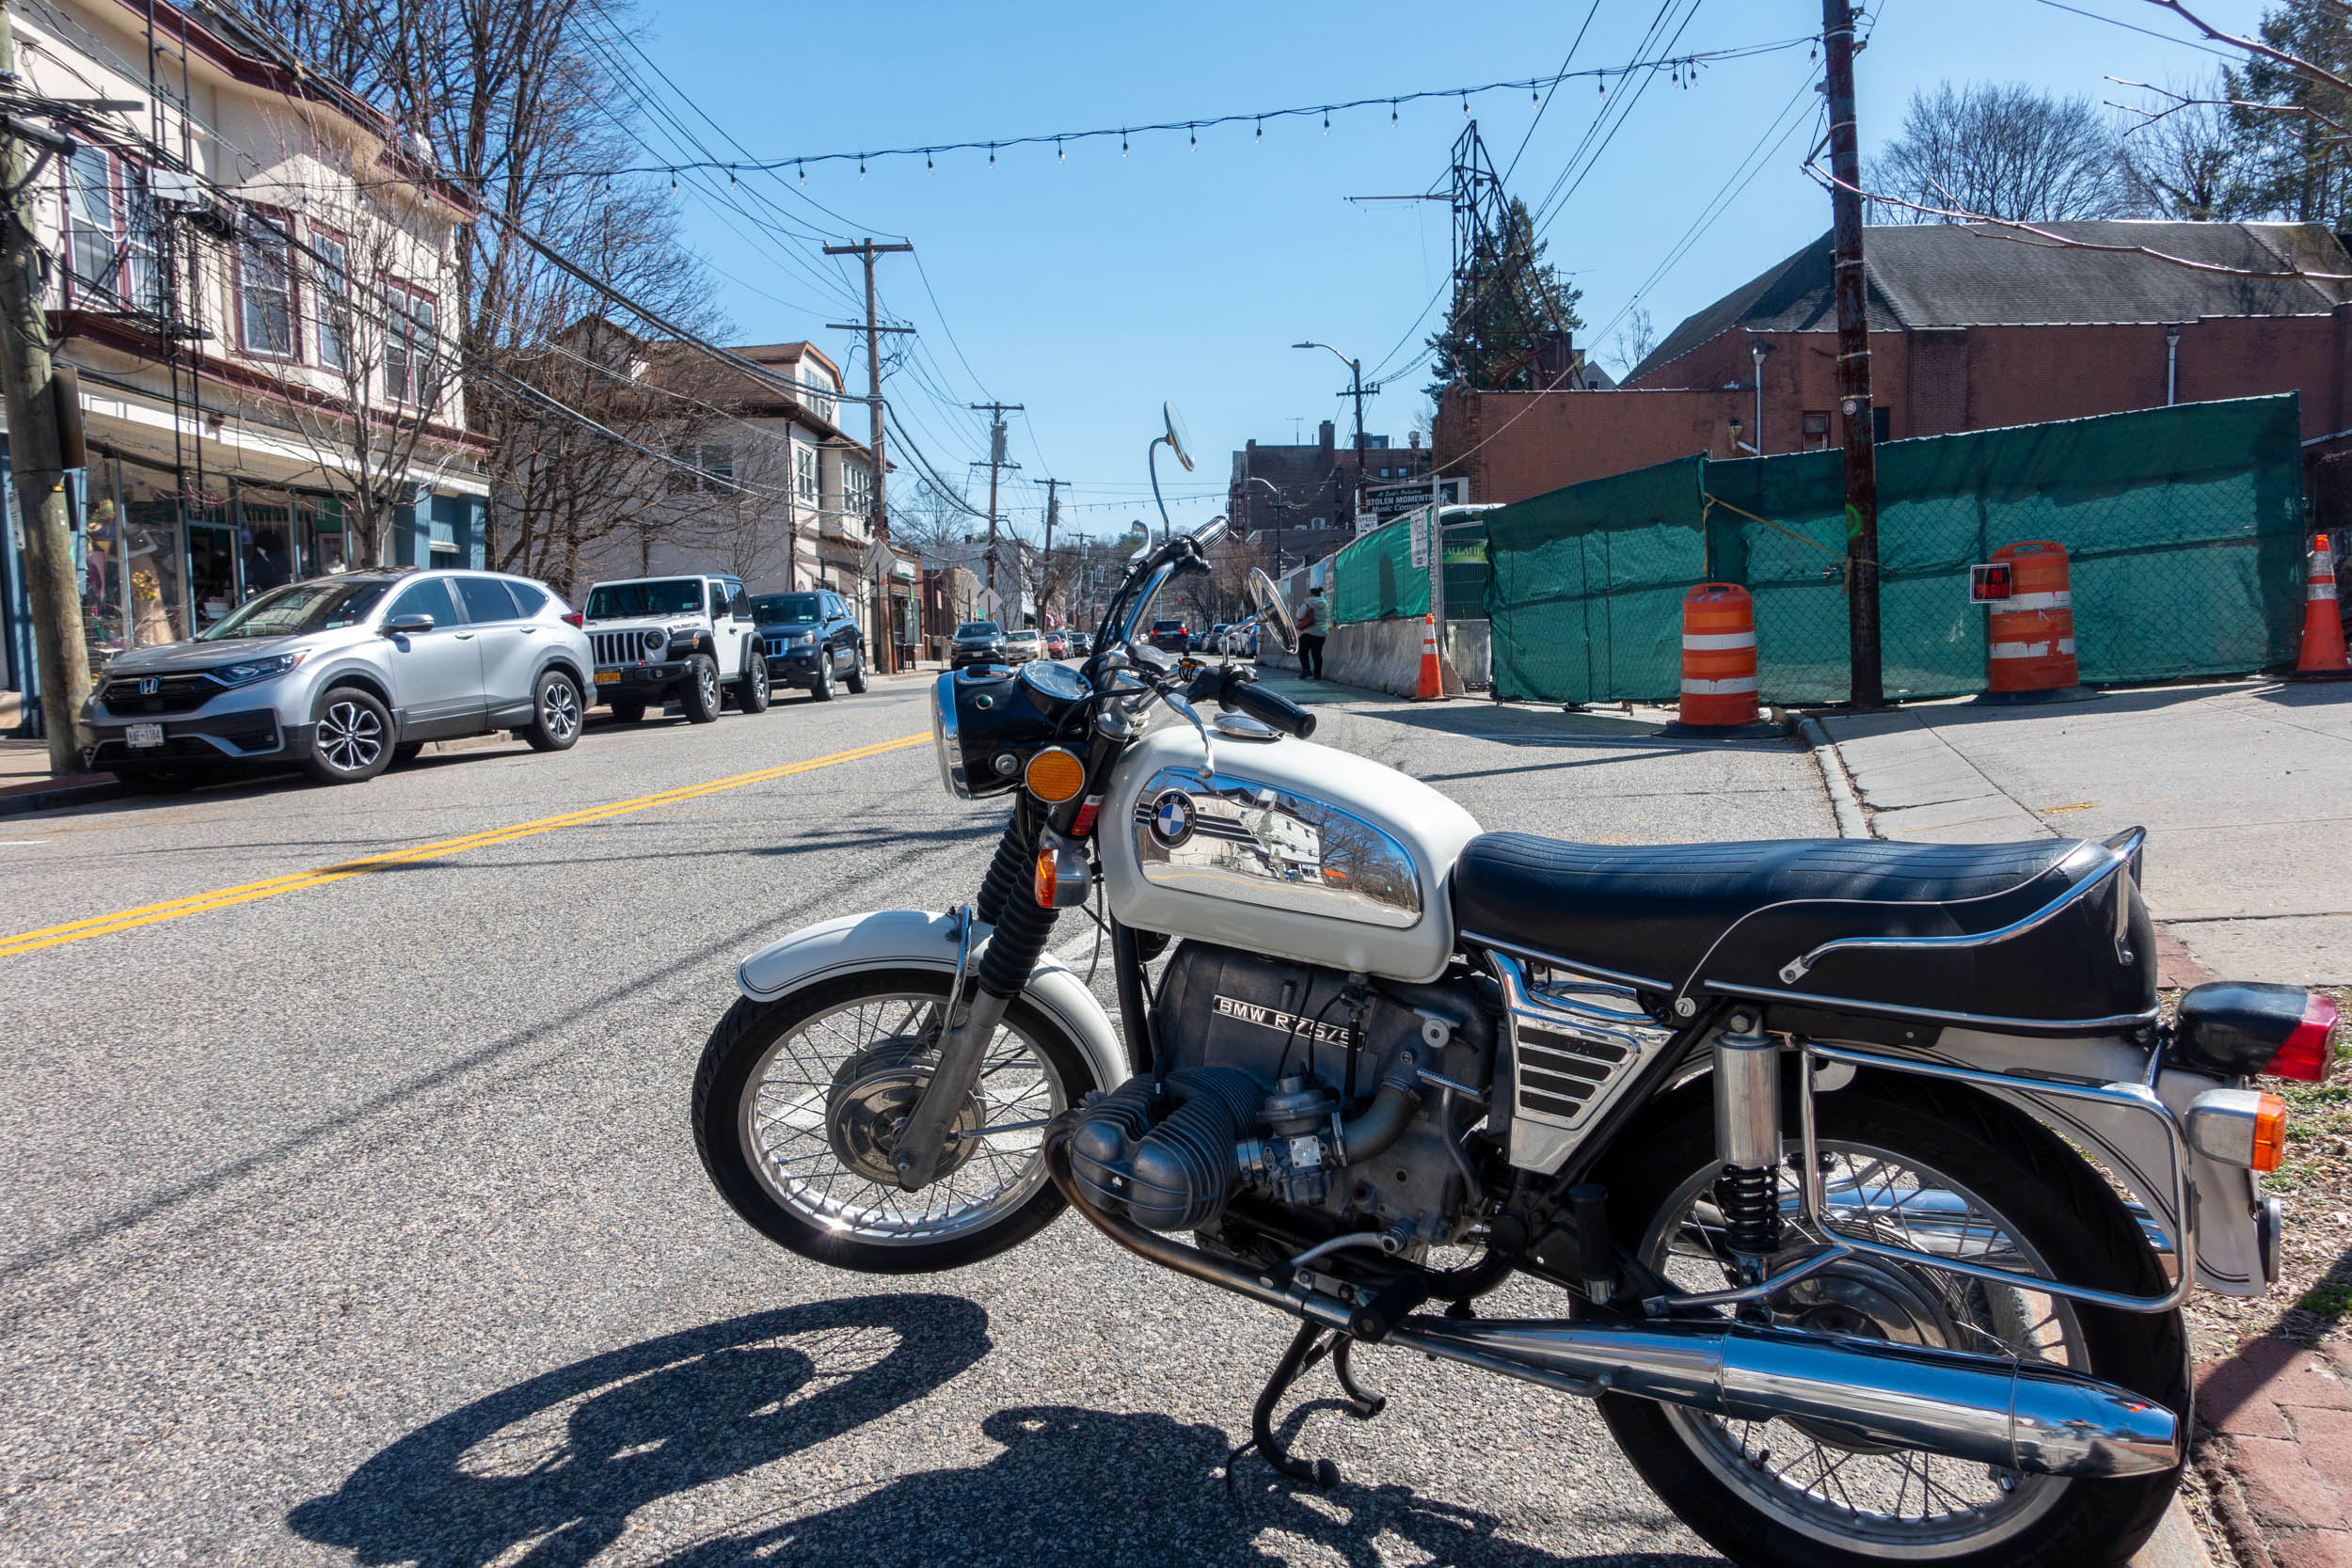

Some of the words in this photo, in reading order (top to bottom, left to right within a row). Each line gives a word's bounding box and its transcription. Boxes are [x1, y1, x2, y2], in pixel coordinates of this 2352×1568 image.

[1367, 497, 1394, 505] STOLEN
[1396, 494, 1434, 503] MOMENTS
[1394, 502, 1425, 512] Comple
[1156, 795, 1192, 814] BMW
[1219, 999, 1266, 1022] BMW
